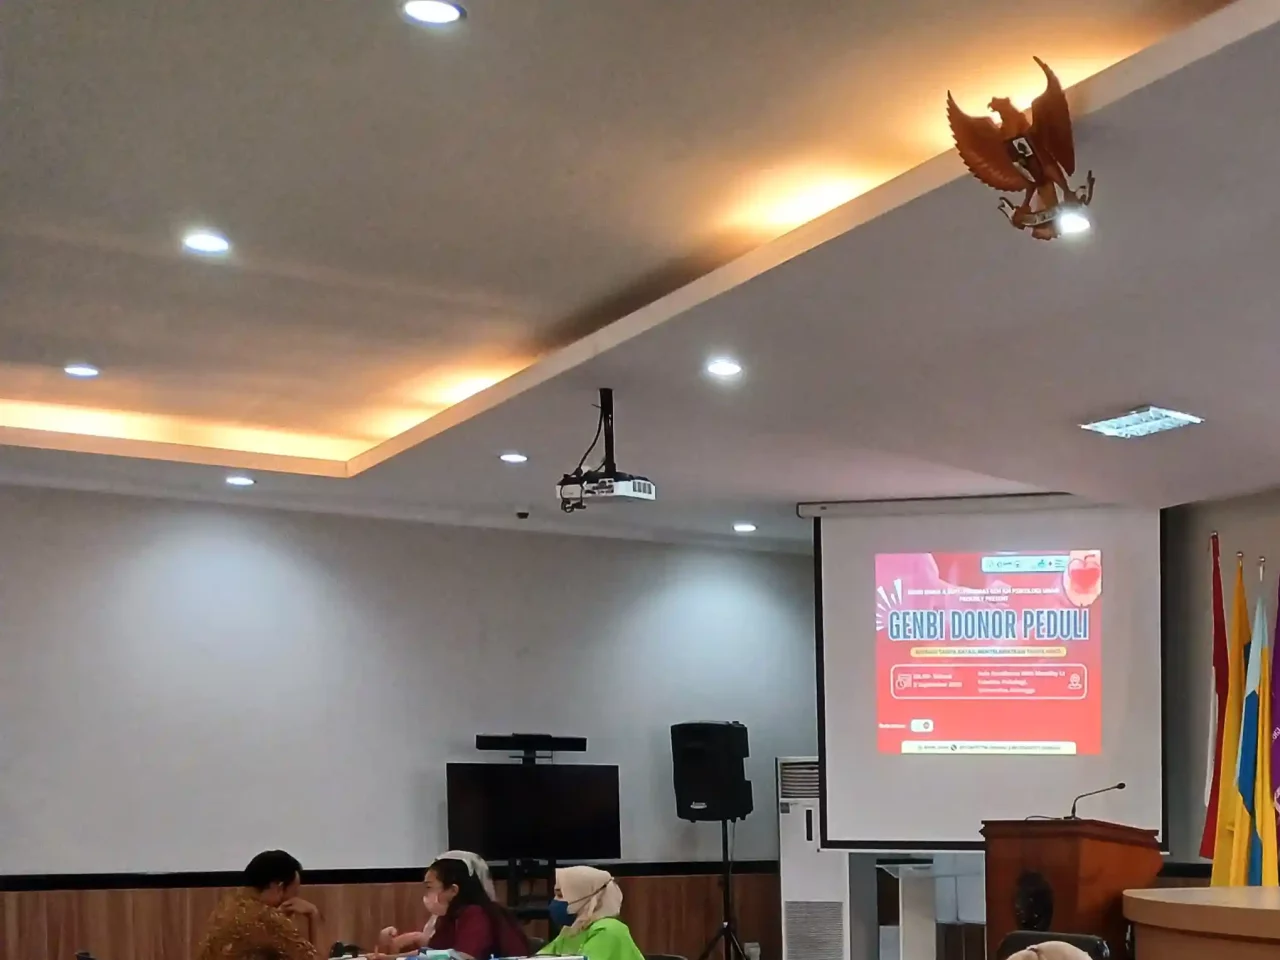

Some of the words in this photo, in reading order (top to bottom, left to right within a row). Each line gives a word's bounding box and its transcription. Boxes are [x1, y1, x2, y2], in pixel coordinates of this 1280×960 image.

[889, 609, 945, 640] GENBI
[951, 609, 1016, 640] DONOR
[1021, 608, 1090, 640] PEDULI
